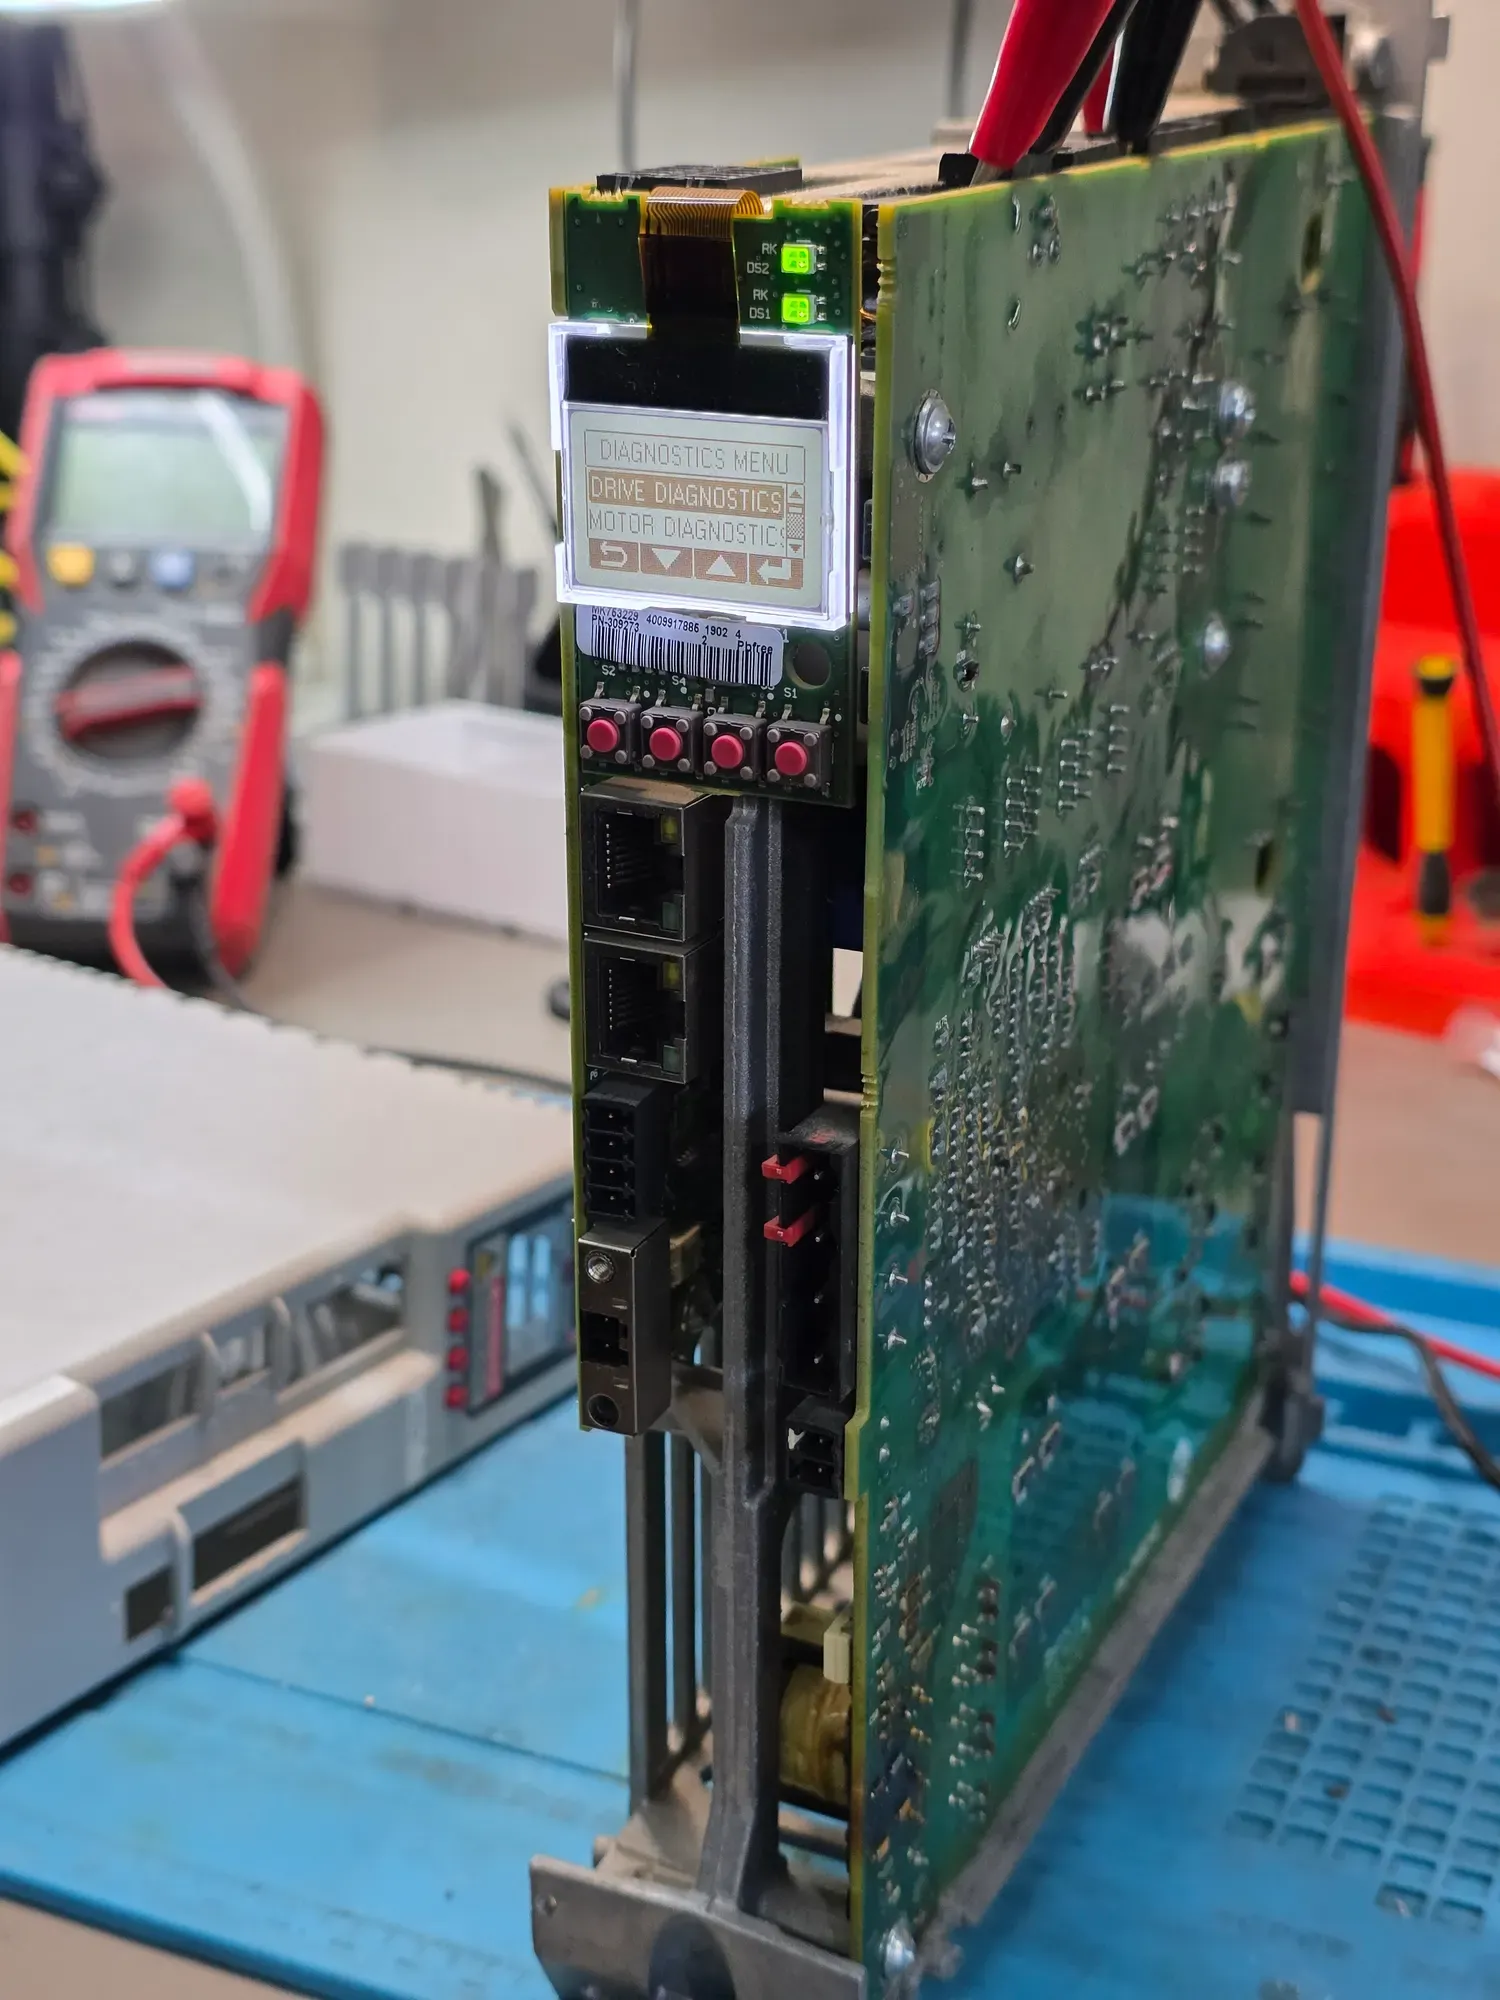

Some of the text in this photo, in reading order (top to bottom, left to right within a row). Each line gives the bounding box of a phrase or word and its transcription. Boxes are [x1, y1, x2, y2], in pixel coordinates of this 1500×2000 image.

[762, 243, 777, 254] RK
[747, 261, 770, 275] DS2
[753, 289, 768, 301] RK
[750, 307, 771, 319] DS1
[600, 439, 789, 475] DIAGNOSTICS MENU
[591, 476, 781, 514] DRIVE DIAGNOSTICS
[589, 508, 654, 535] MOTOR
[646, 614, 700, 633] 4009917886
[705, 625, 728, 638] 1902
[735, 629, 742, 639] 4
[591, 614, 774, 655] PN-309273 2 Pbfree
[601, 664, 616, 677] S2
[672, 675, 686, 687] S4
[783, 687, 798, 699] S1
